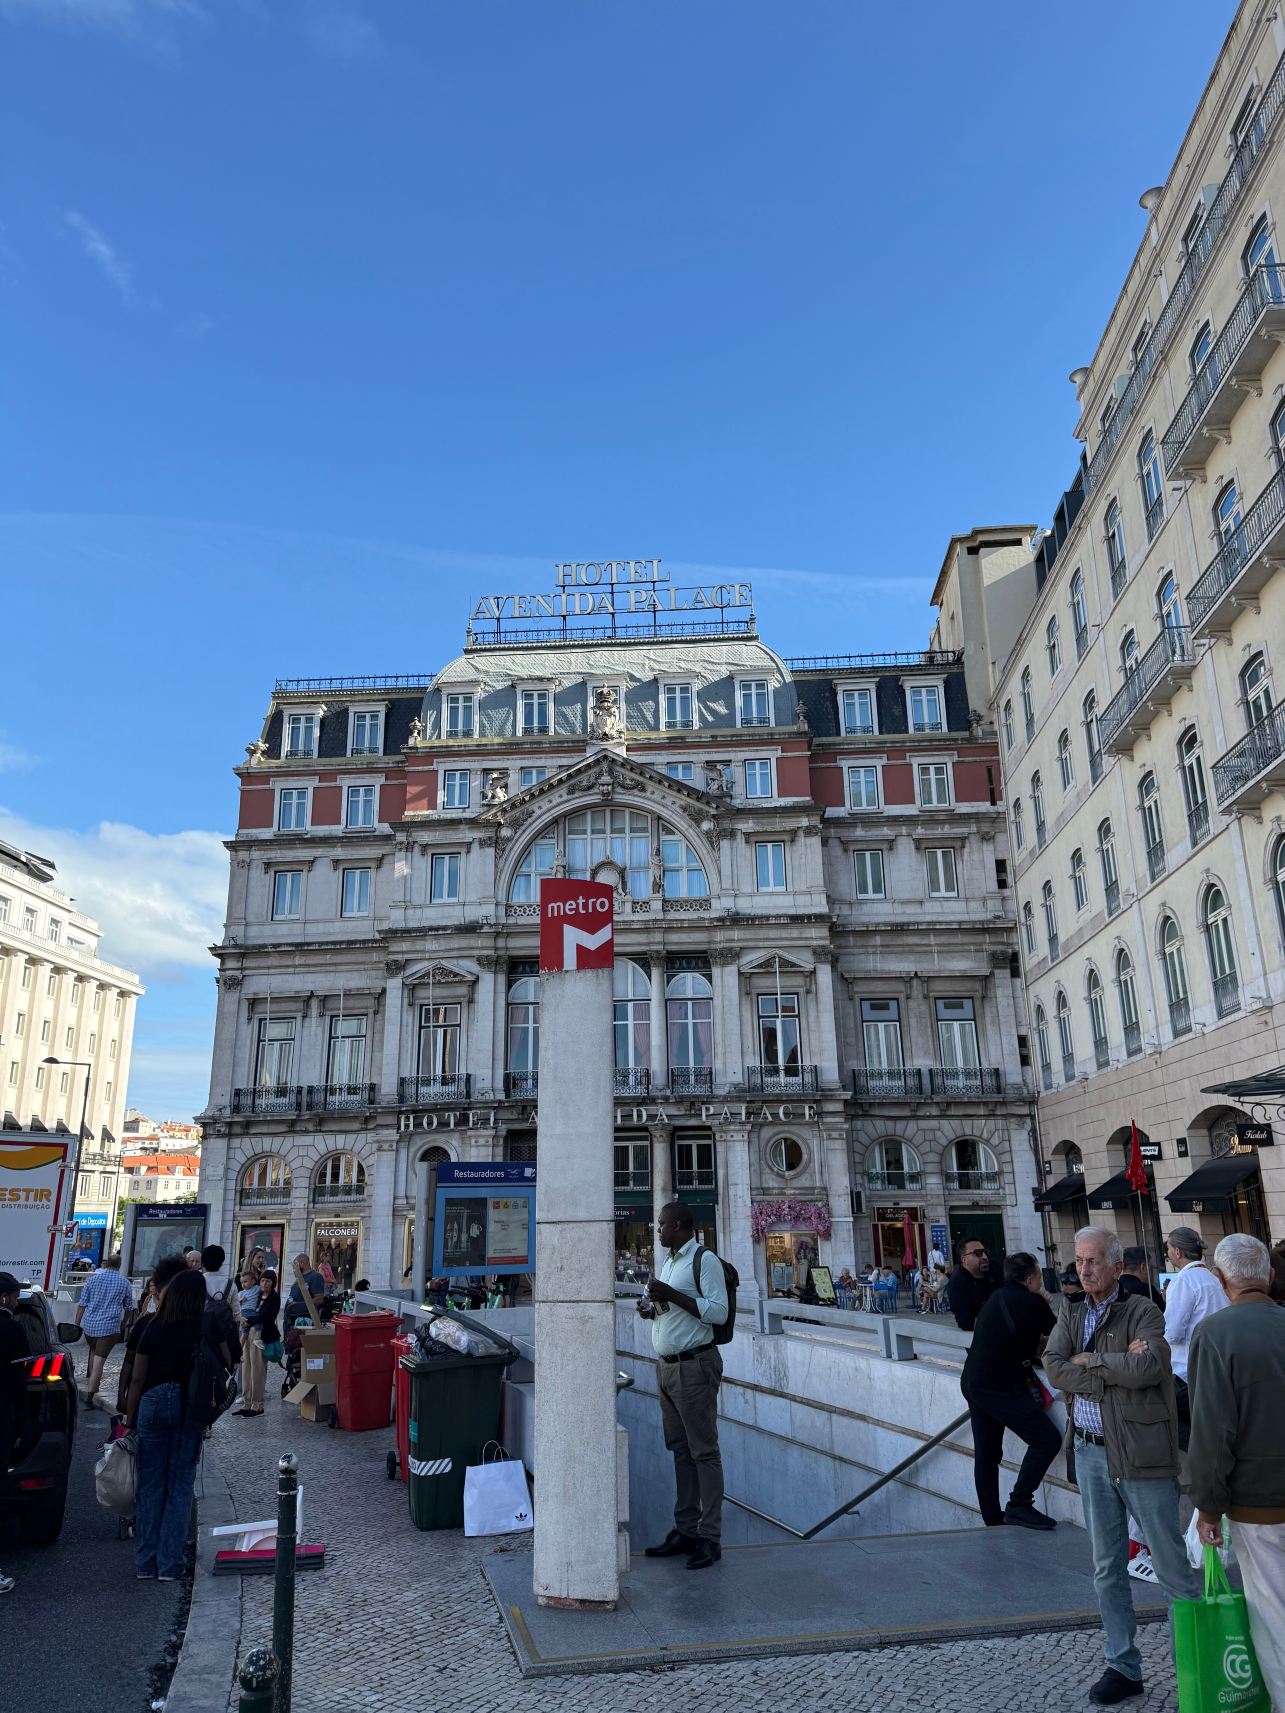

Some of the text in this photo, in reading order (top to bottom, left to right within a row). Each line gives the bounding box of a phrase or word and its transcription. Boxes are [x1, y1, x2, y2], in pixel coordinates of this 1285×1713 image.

[556, 559, 670, 586] HOTEL
[471, 583, 752, 619] AVENIDA PALACE
[547, 896, 609, 917] metro
[400, 1109, 502, 1132] HOTEL
[701, 1104, 818, 1122] PALACE
[454, 1170, 505, 1178] Restauradores
